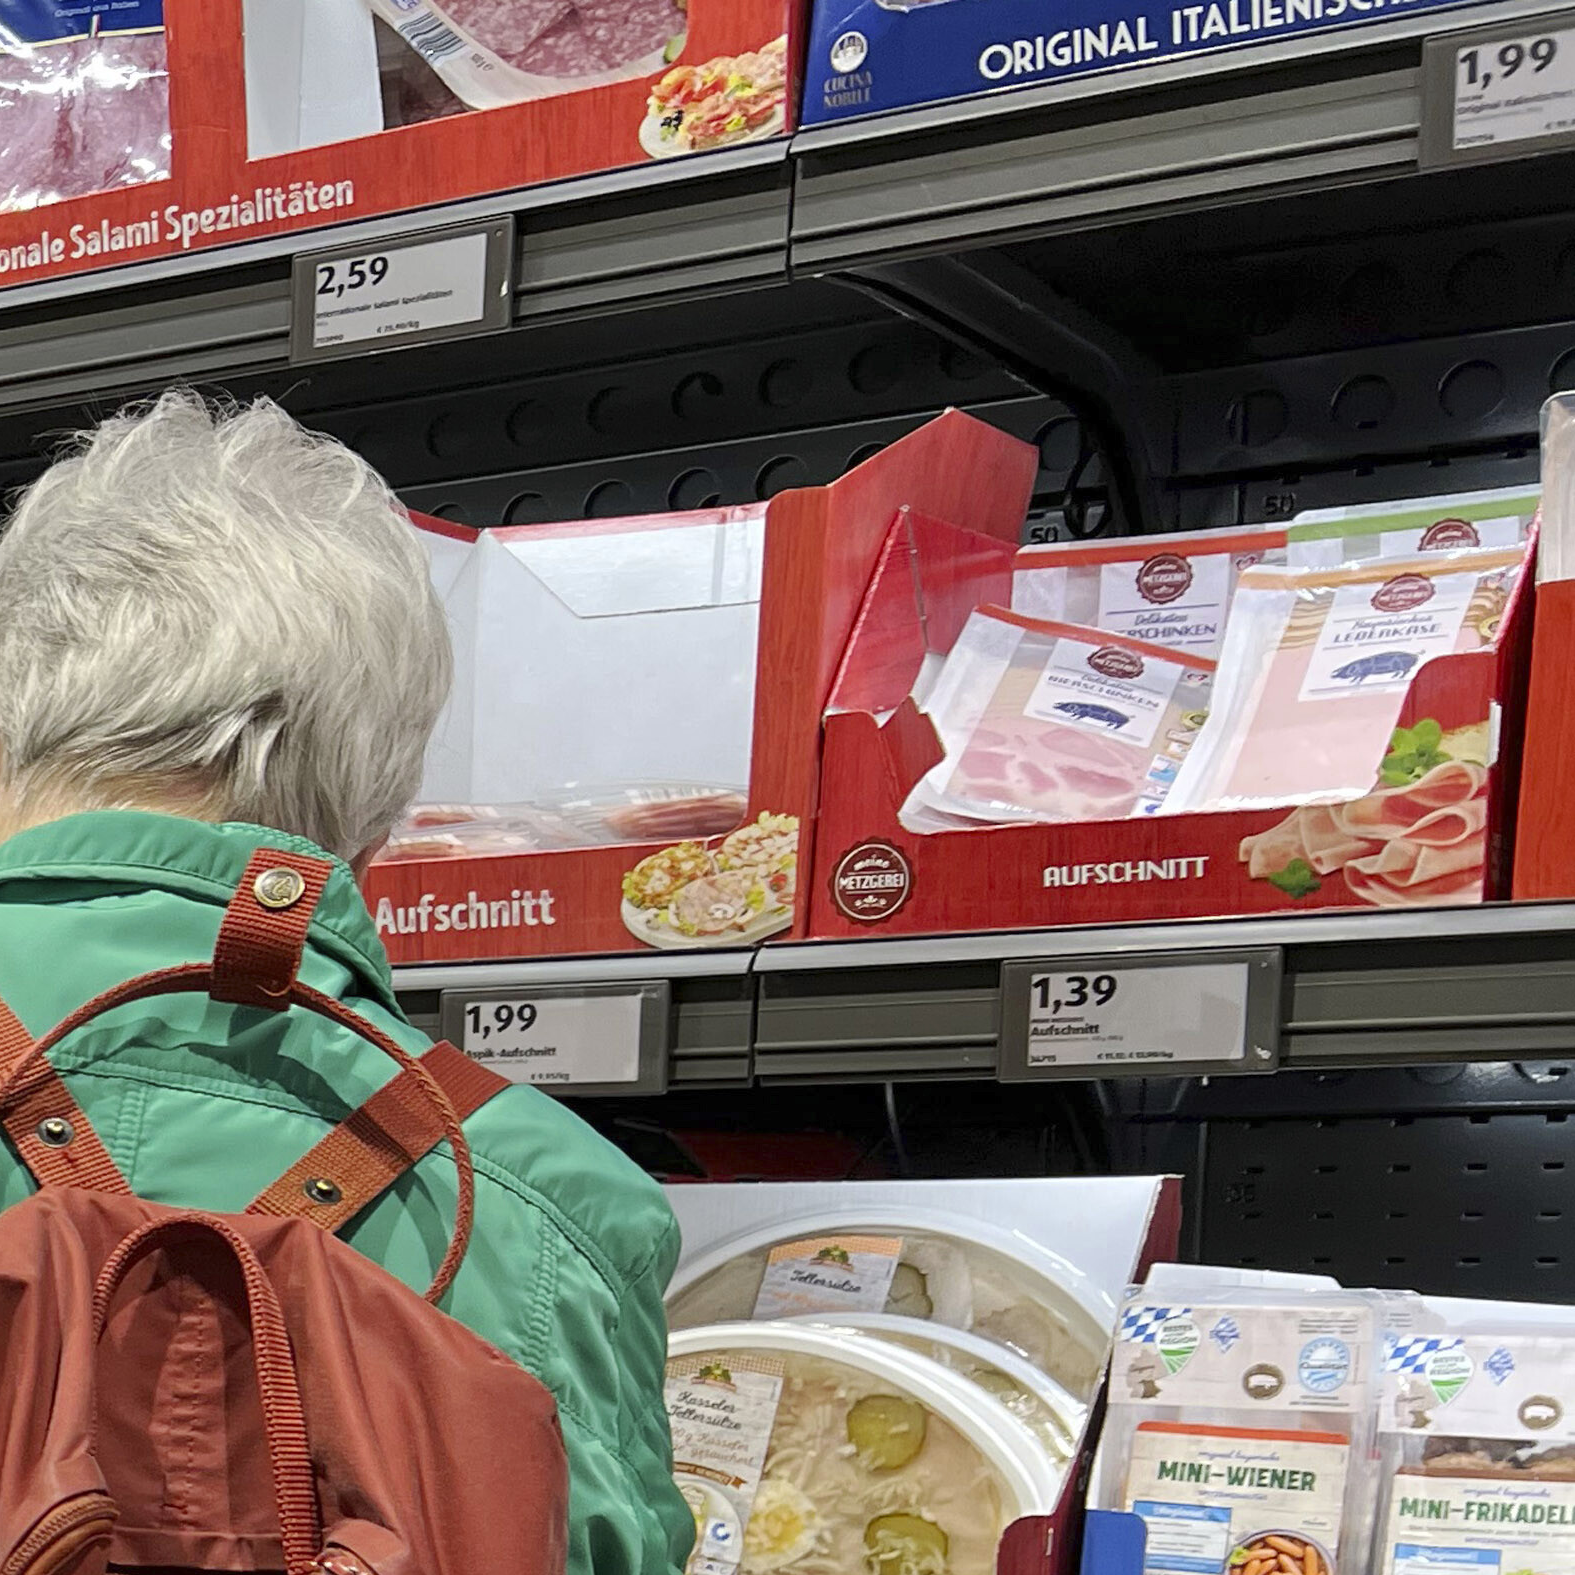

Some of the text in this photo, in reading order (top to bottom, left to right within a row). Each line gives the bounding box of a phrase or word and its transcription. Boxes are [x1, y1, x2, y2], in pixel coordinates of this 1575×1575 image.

[978, 16, 1159, 81] ORIGINAL
[1457, 37, 1558, 91] 1,99
[823, 71, 872, 95] CUCINA
[823, 88, 871, 109] NOBILE
[69, 212, 160, 258] Salami
[165, 177, 355, 250] Spezialitäten
[316, 255, 389, 299] 2,59
[838, 872, 905, 891] METZGEREI
[1042, 856, 1209, 888] AUFSCHNITT
[375, 889, 557, 936] Aufschnitt
[1032, 974, 1118, 1015] 1,39
[466, 1003, 538, 1040] 1,99
[1158, 1460, 1316, 1492] MINI-WIENER
